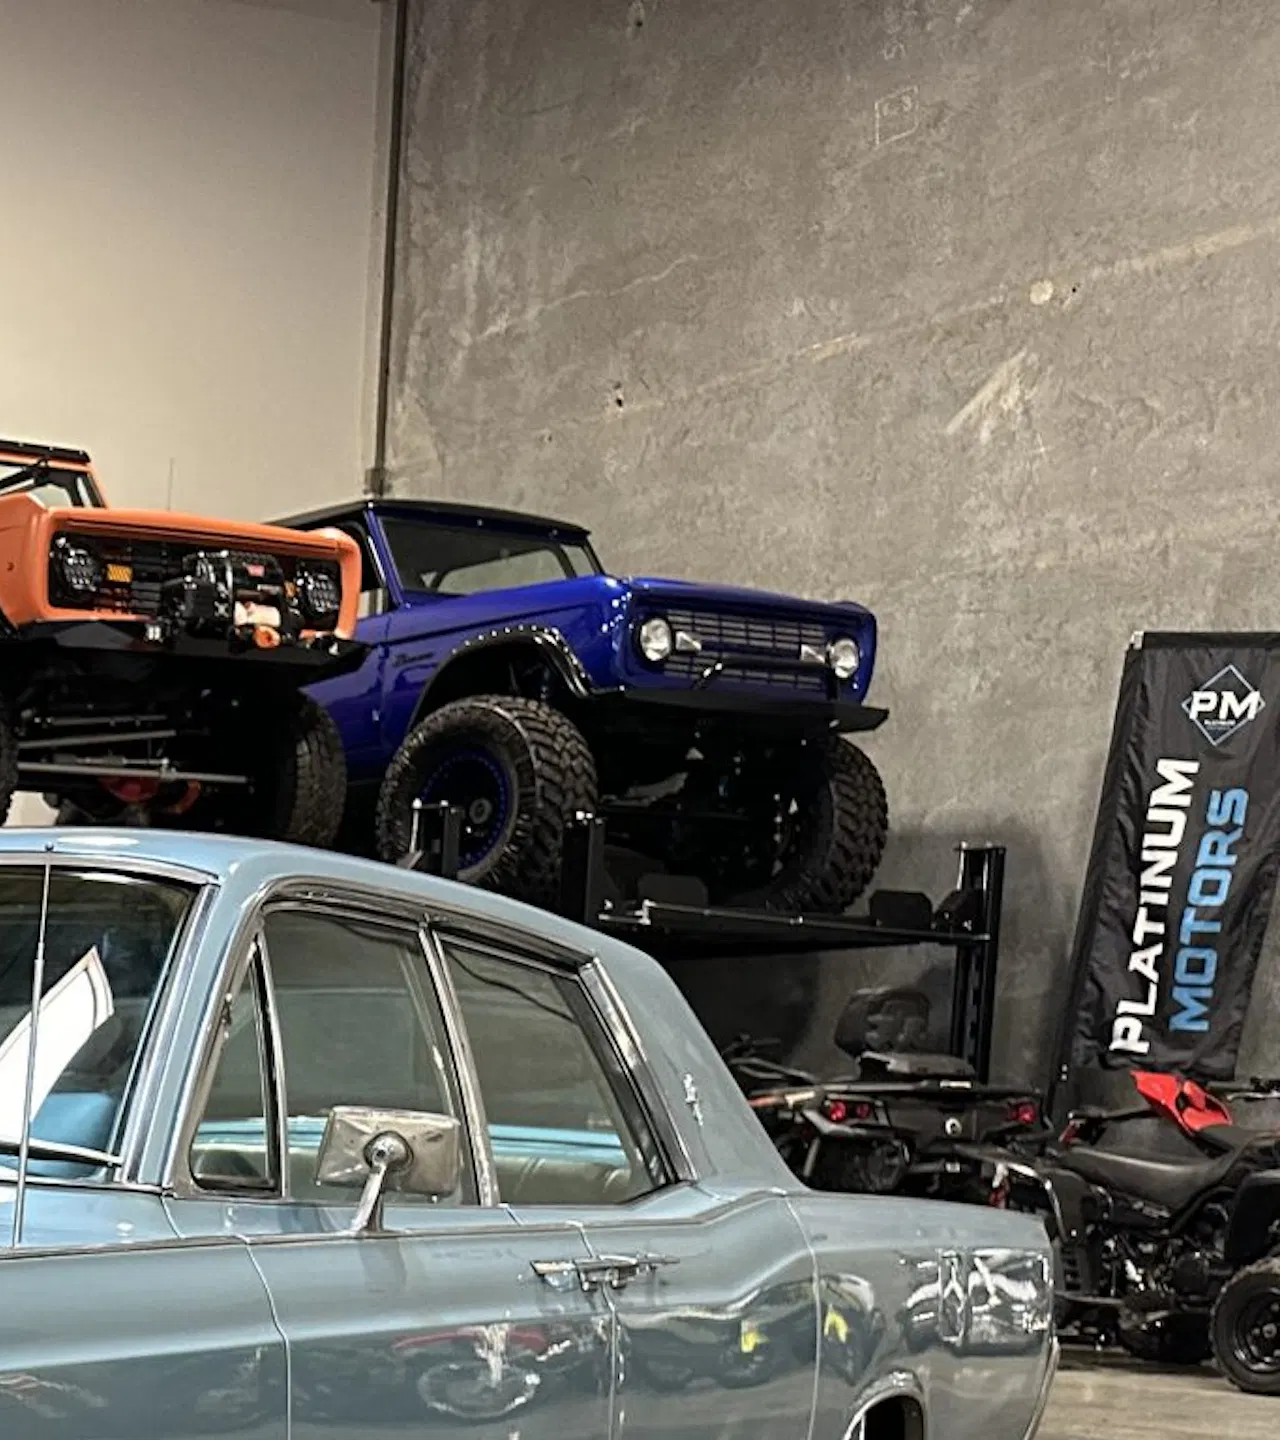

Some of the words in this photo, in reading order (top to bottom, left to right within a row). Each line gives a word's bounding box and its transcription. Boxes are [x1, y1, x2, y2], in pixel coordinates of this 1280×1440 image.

[1189, 690, 1260, 720] PM
[1109, 757, 1200, 1054] PLATINUM
[1169, 787, 1250, 1033] MOTORS
